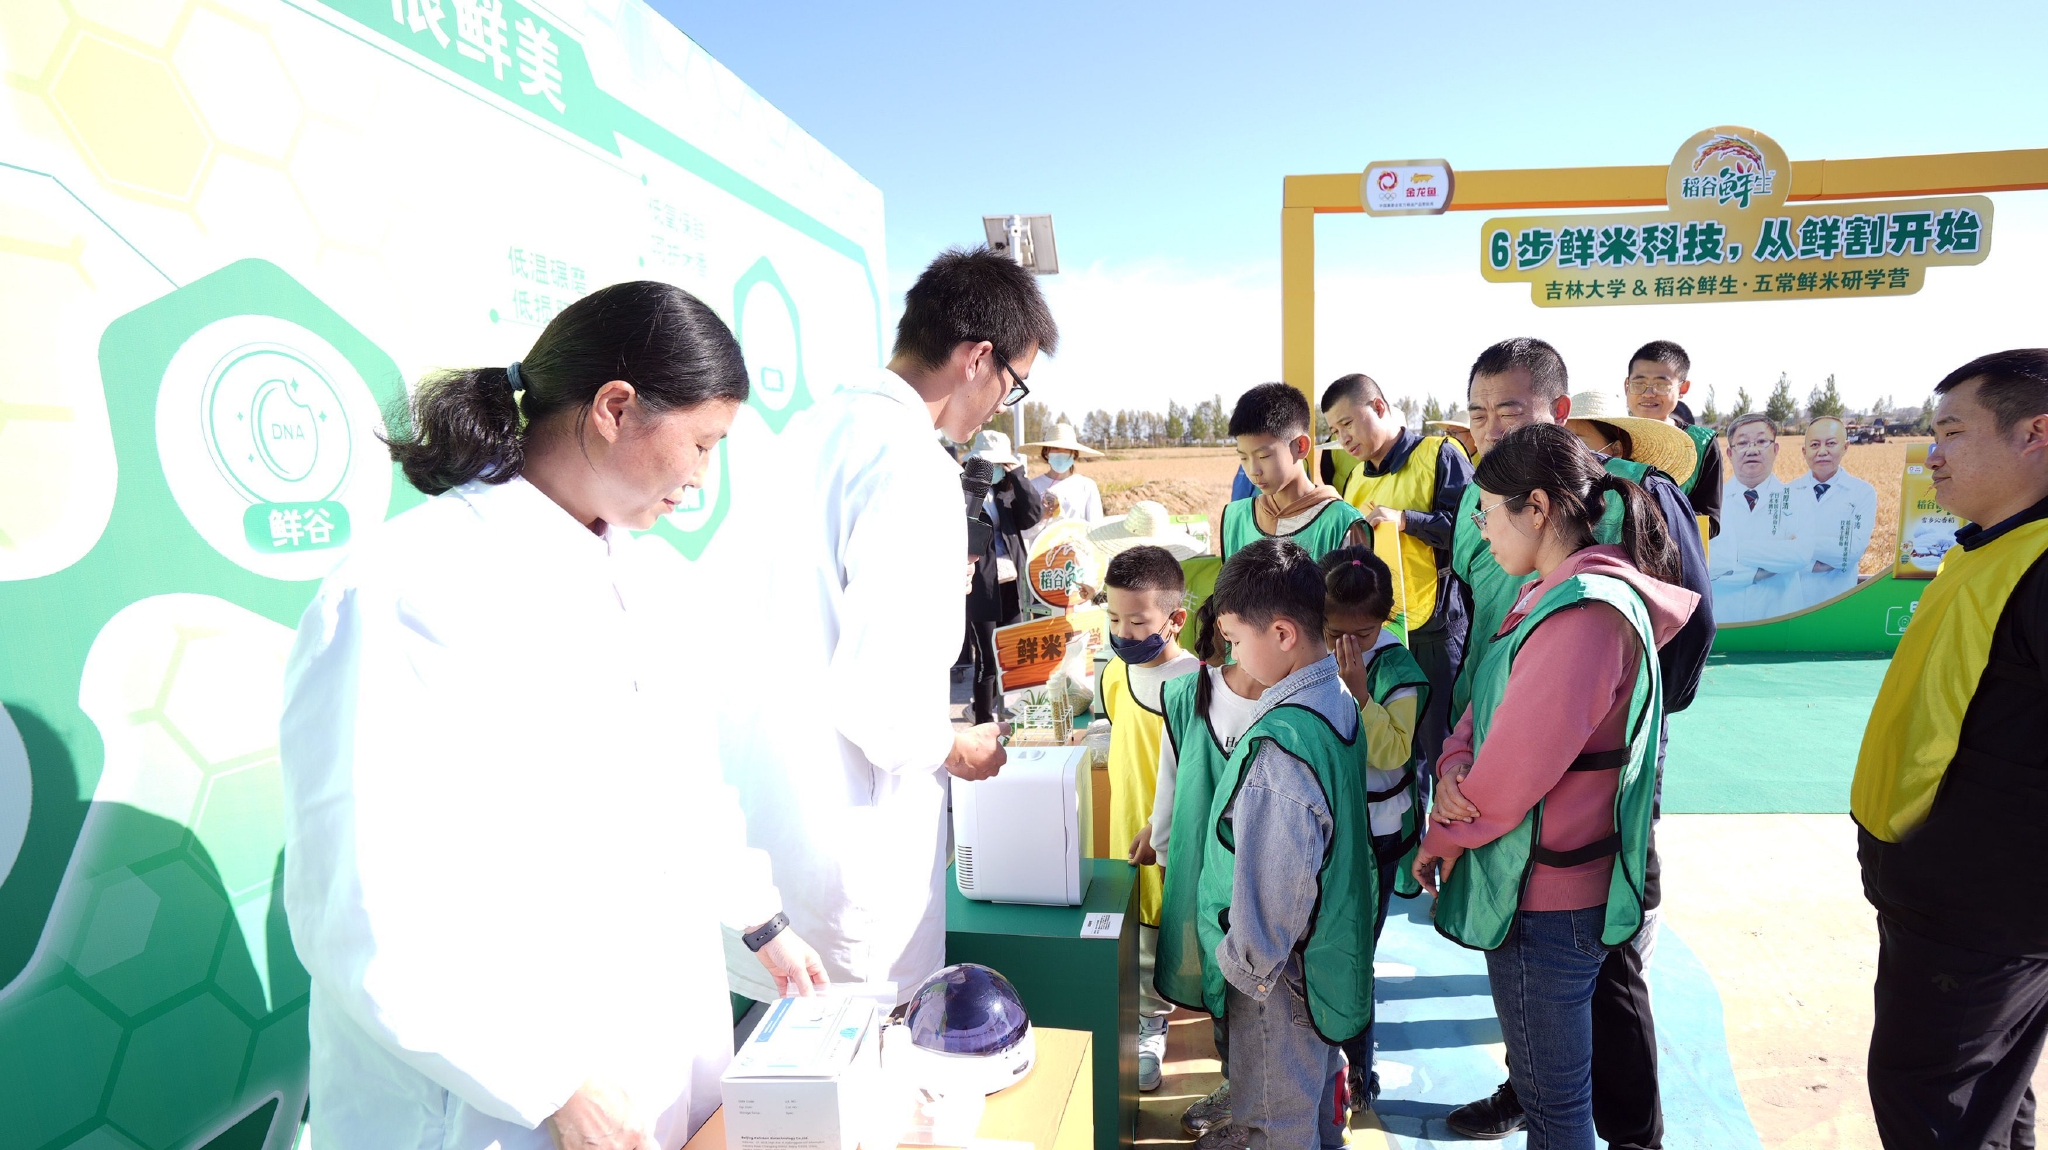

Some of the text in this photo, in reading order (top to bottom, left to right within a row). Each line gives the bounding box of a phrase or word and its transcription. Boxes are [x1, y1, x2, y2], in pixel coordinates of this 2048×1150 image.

[1405, 187, 1437, 198] 金龙鱼
[1682, 167, 1772, 208] 稻谷鲜生
[1545, 279, 1626, 300] 吉林大学
[1632, 280, 1648, 296] &
[271, 423, 305, 440] DNA
[268, 507, 335, 547] 鲜谷
